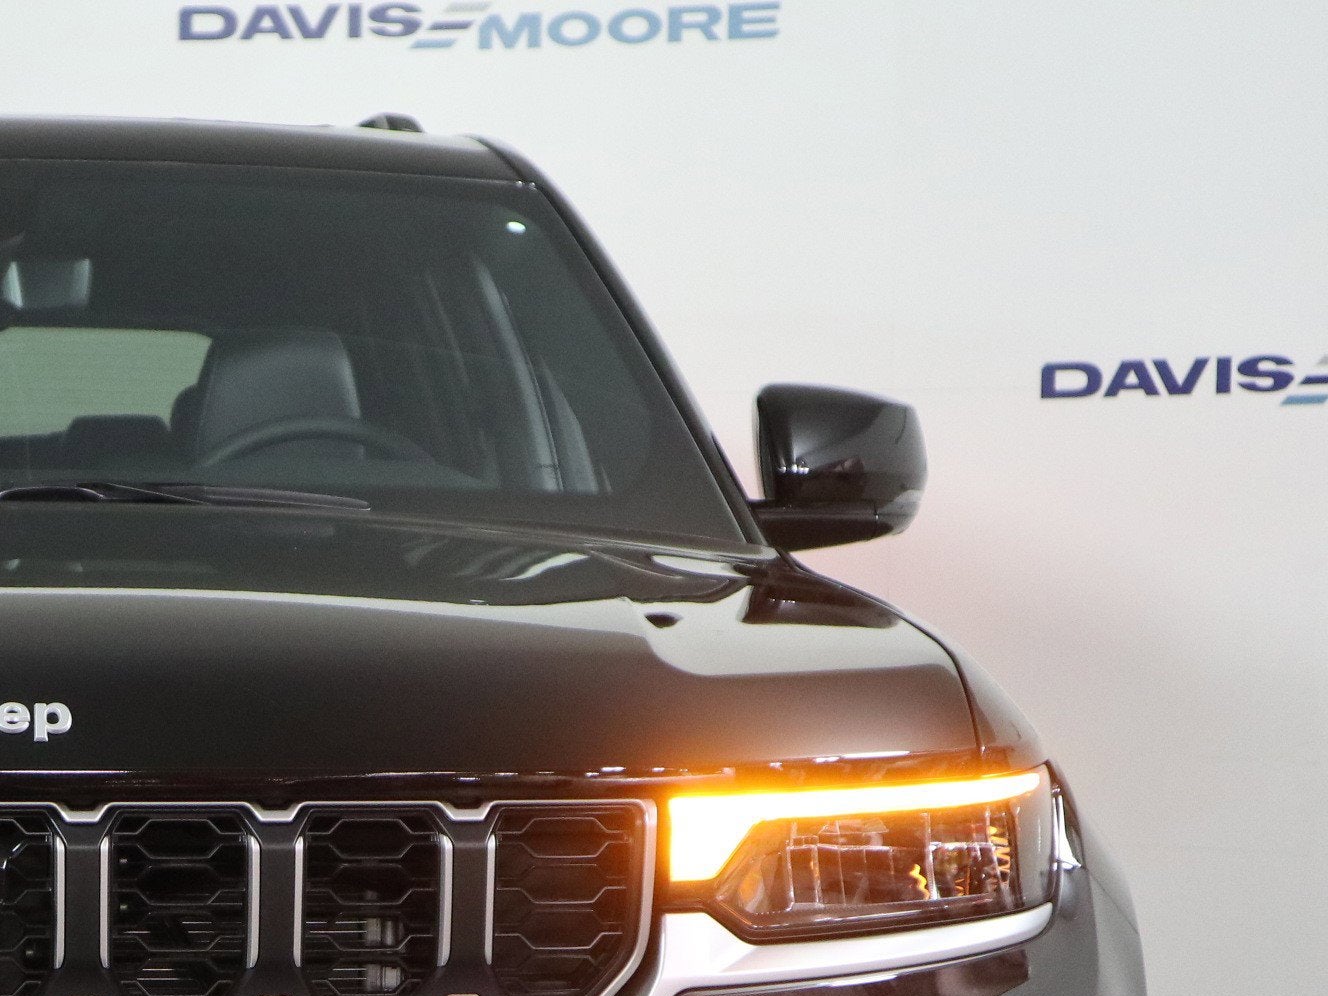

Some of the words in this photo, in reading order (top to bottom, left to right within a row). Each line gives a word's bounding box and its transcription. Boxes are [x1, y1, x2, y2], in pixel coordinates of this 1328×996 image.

[179, 2, 423, 41] DAVIS
[478, 1, 782, 49] MOORE
[1040, 354, 1294, 399] DAVIS
